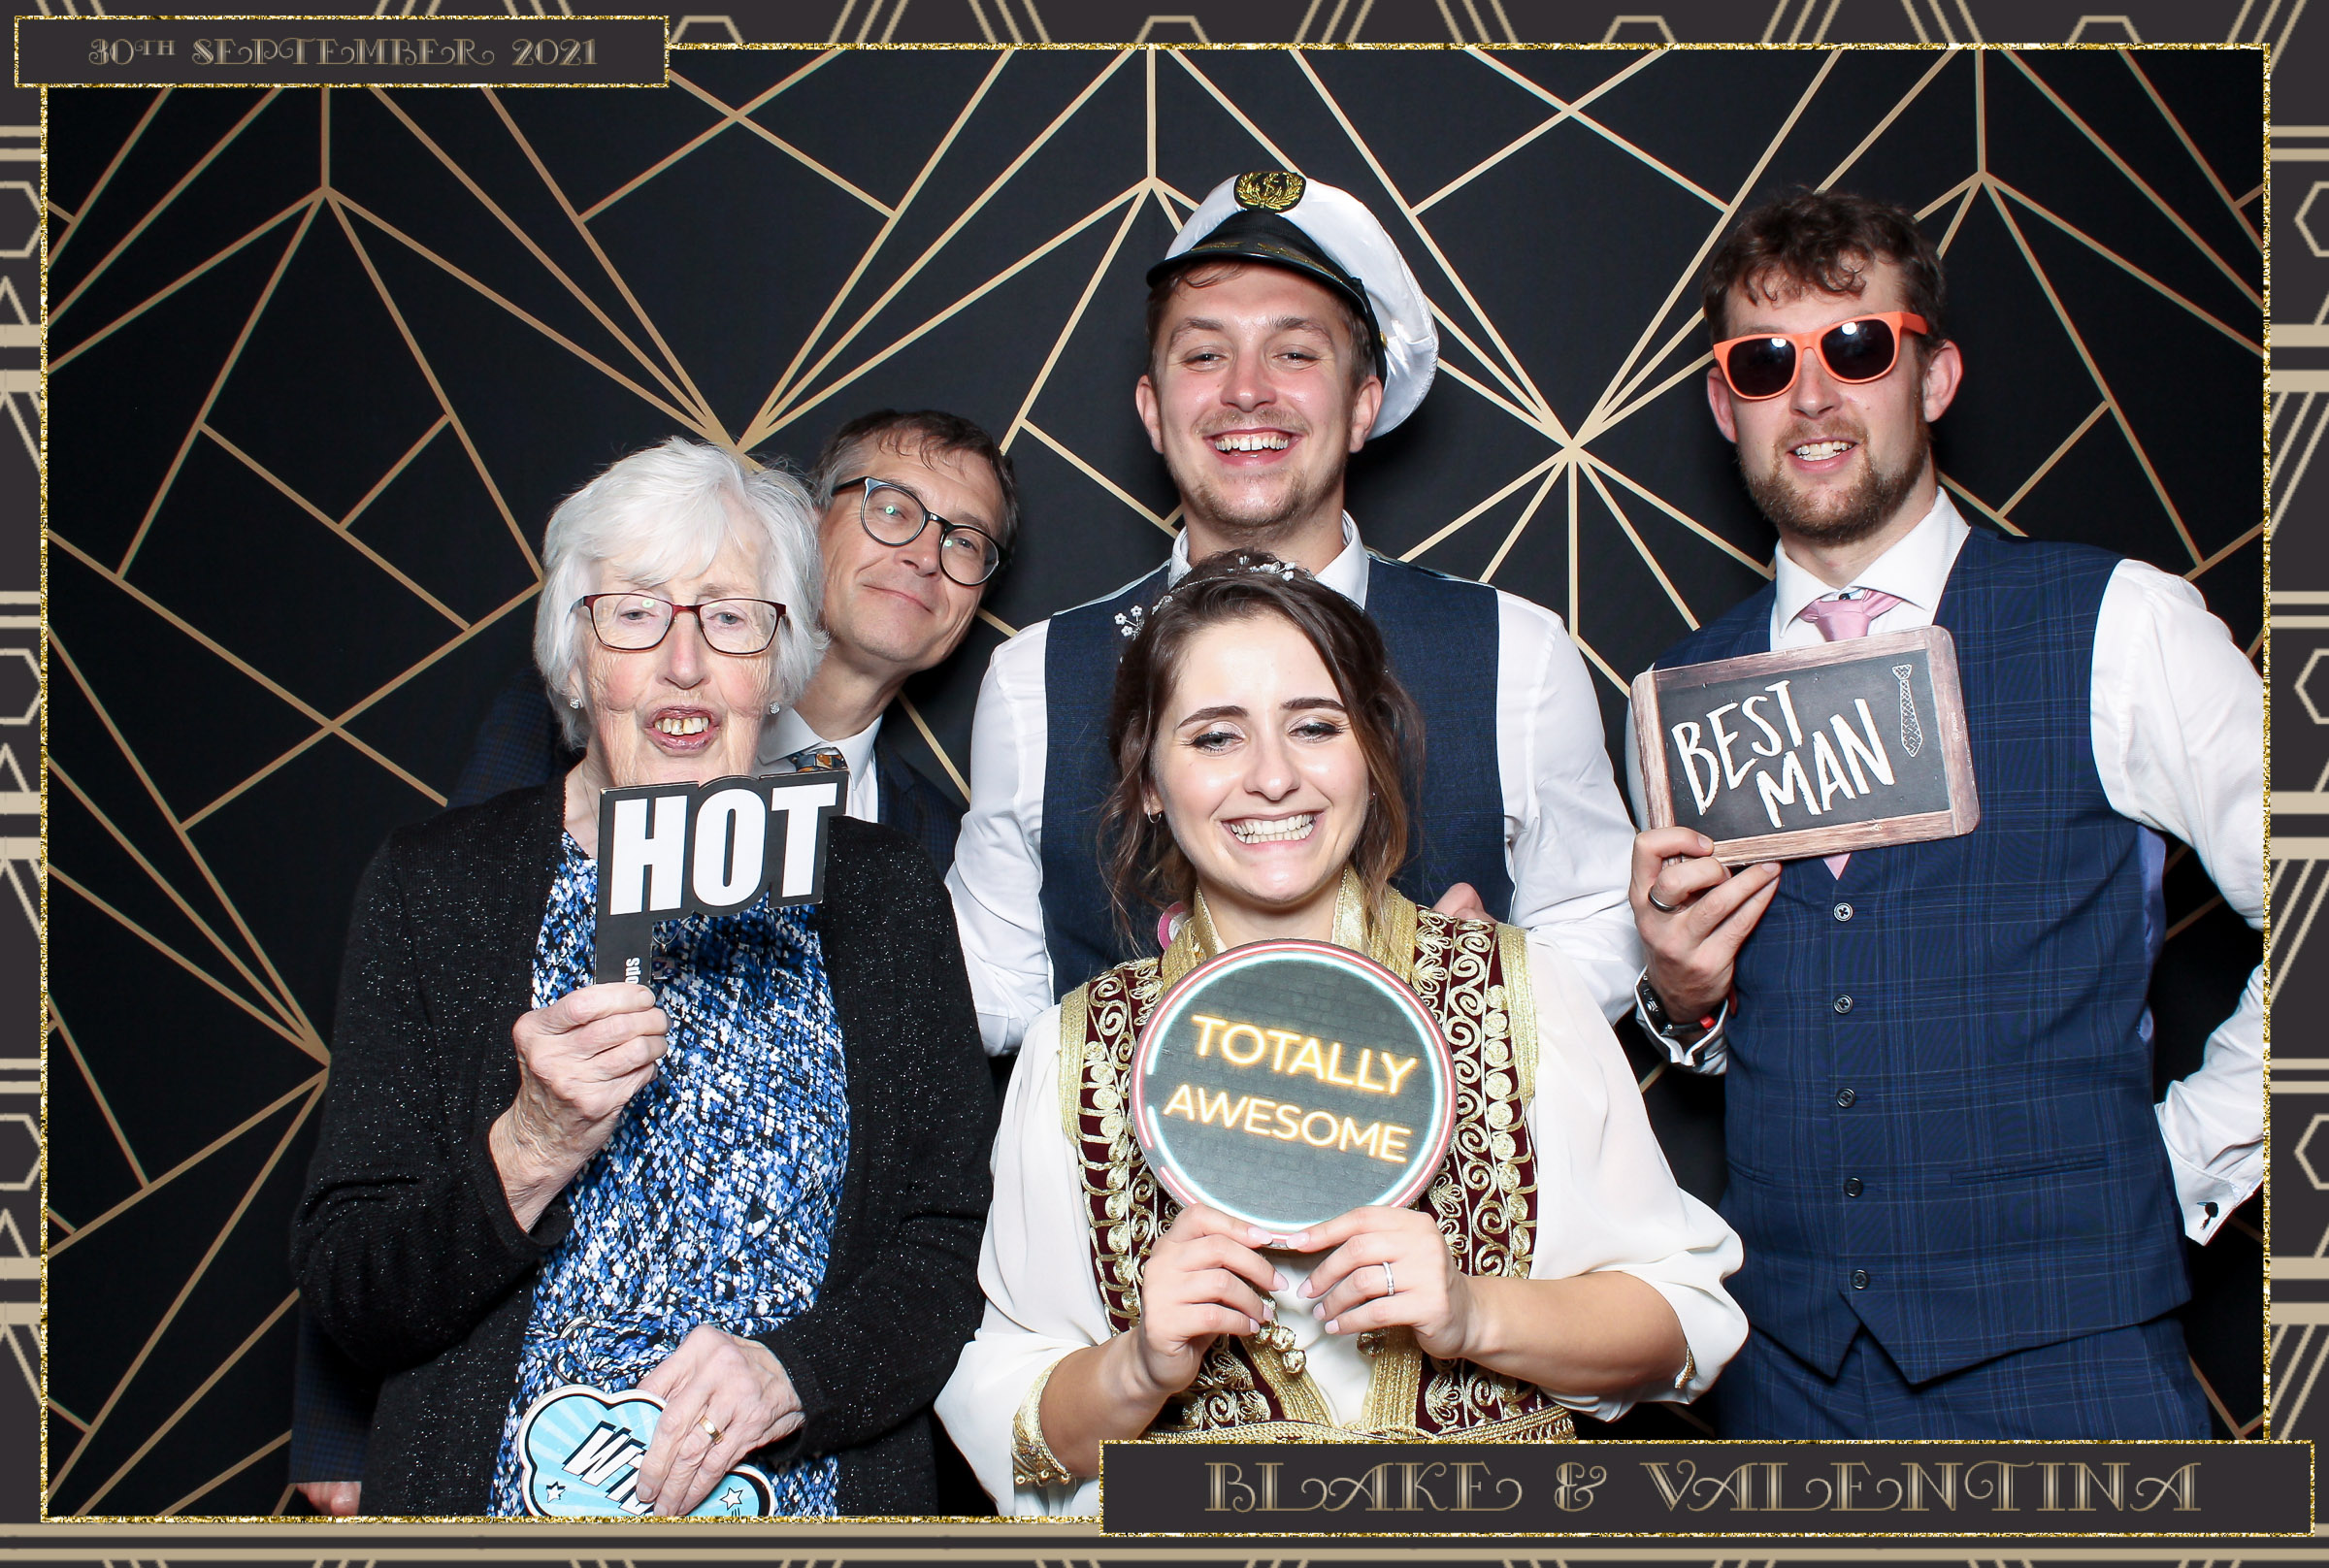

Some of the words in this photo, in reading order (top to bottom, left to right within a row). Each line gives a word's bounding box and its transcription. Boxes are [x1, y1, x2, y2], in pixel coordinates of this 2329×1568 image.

[1670, 679, 1803, 816] BEST
[1755, 698, 1895, 829] MAN
[609, 782, 838, 916] HOT
[1192, 1014, 1419, 1095] TOTALLY
[1163, 1083, 1413, 1163] AWESOME
